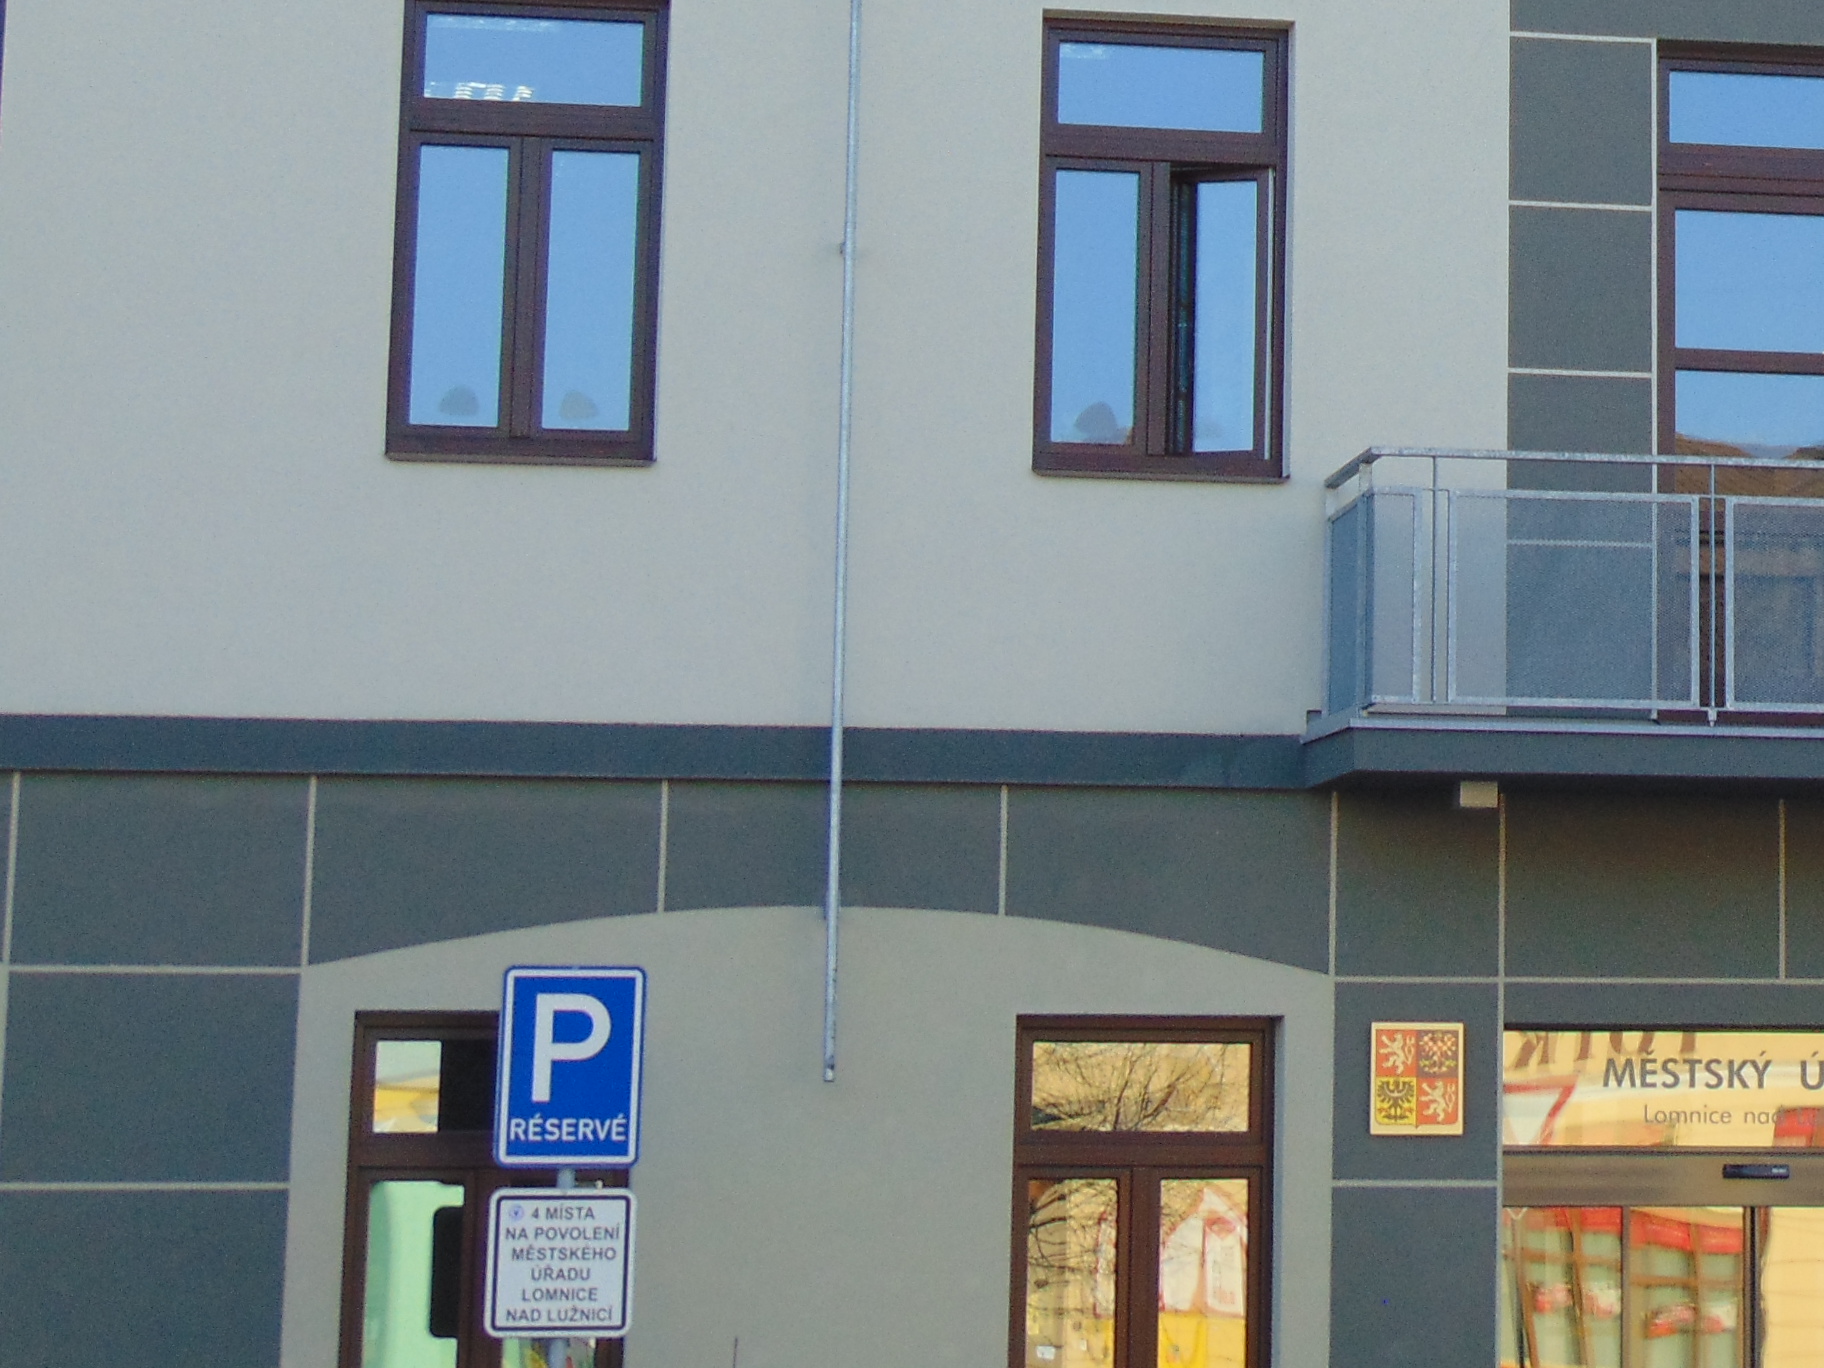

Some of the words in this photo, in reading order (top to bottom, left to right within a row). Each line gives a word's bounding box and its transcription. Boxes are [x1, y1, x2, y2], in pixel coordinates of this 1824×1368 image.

[531, 992, 612, 1103] P
[1602, 1049, 1773, 1090] MĚSTSKÝ
[1643, 1104, 1732, 1125] Lomnice
[509, 1113, 628, 1143] RÉSERVÉ
[531, 1207, 540, 1220] 4
[545, 1204, 595, 1220] MÍSTA
[505, 1228, 528, 1240] NA
[534, 1223, 620, 1240] POVOLENÍ
[511, 1244, 617, 1261] MĚSTSKÉHO
[531, 1264, 591, 1281] ÚŘADU
[522, 1288, 598, 1302] LOMNICE
[506, 1308, 541, 1322] NAD
[547, 1305, 612, 1322] LUŽNICÍ
